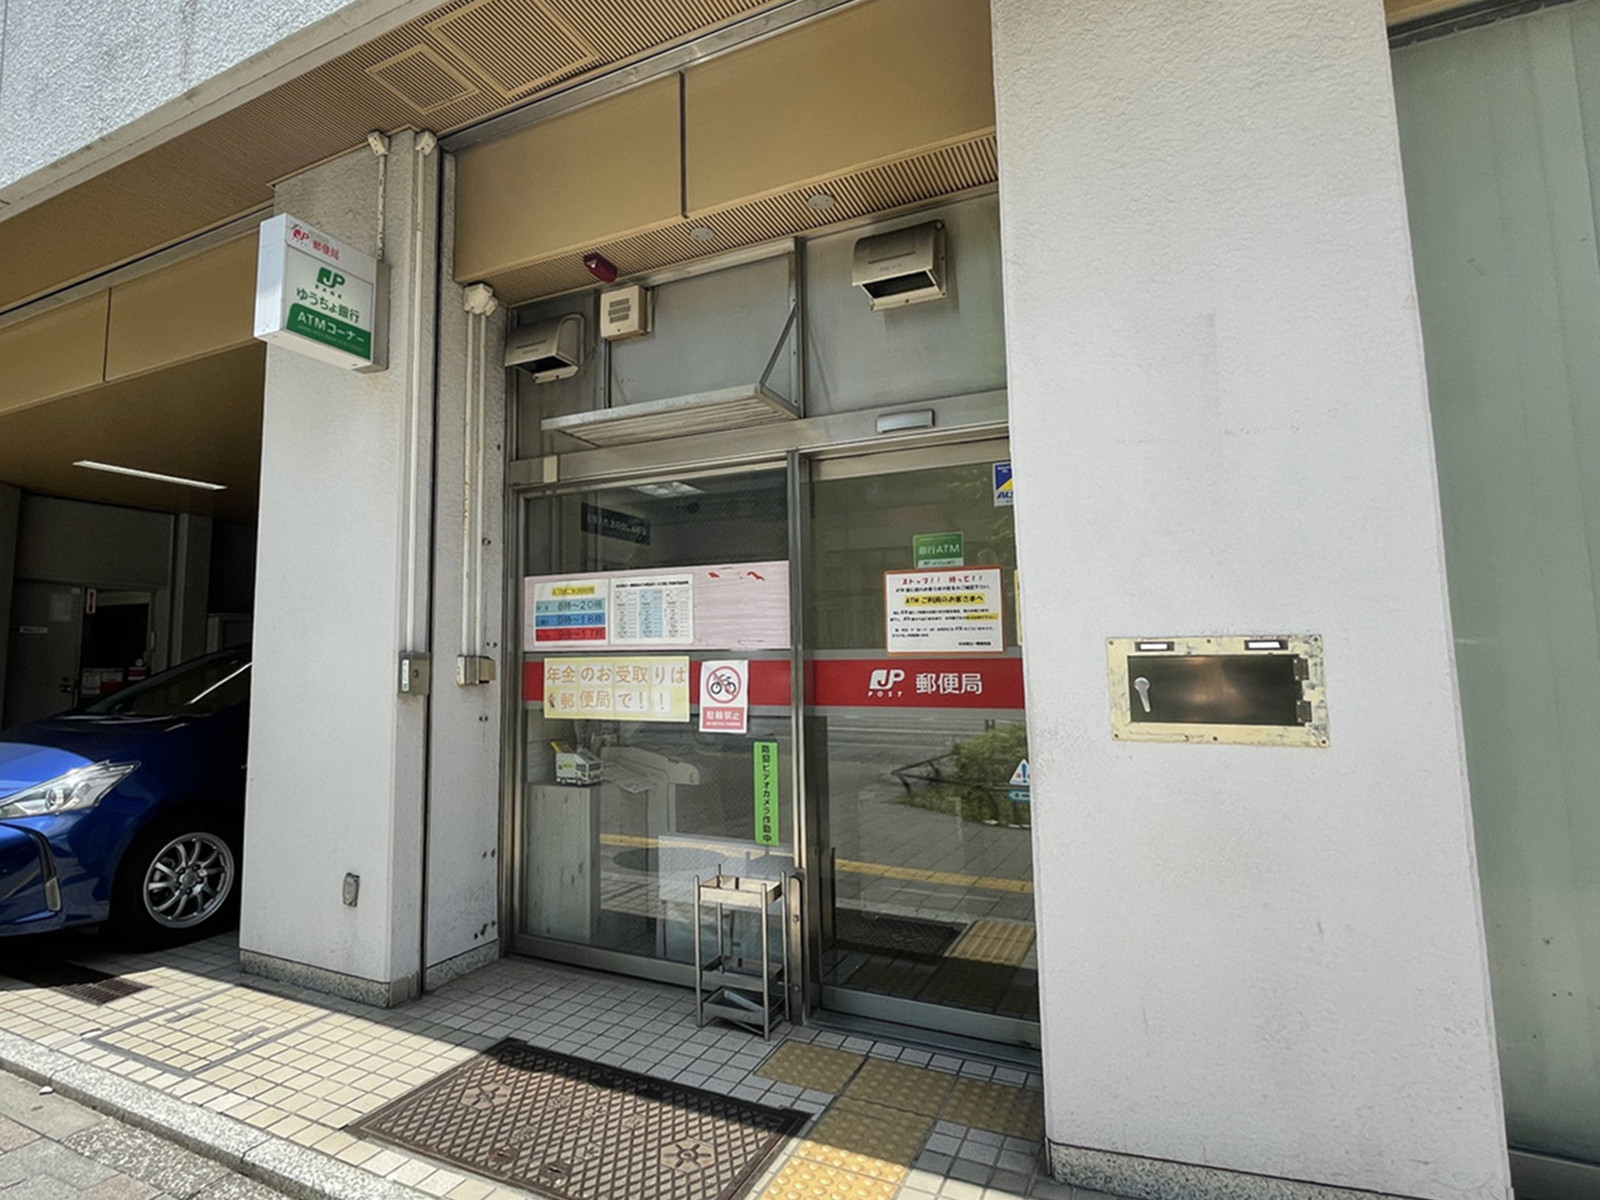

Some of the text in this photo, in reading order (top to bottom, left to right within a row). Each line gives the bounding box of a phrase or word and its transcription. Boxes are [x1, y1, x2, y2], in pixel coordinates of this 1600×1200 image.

[317, 267, 346, 289] JP
[296, 287, 360, 323] ゆうちょ銀行
[297, 311, 364, 342] ATMコーナー
[546, 665, 686, 684] 年金のお受取りは
[916, 672, 982, 694] 郵便局
